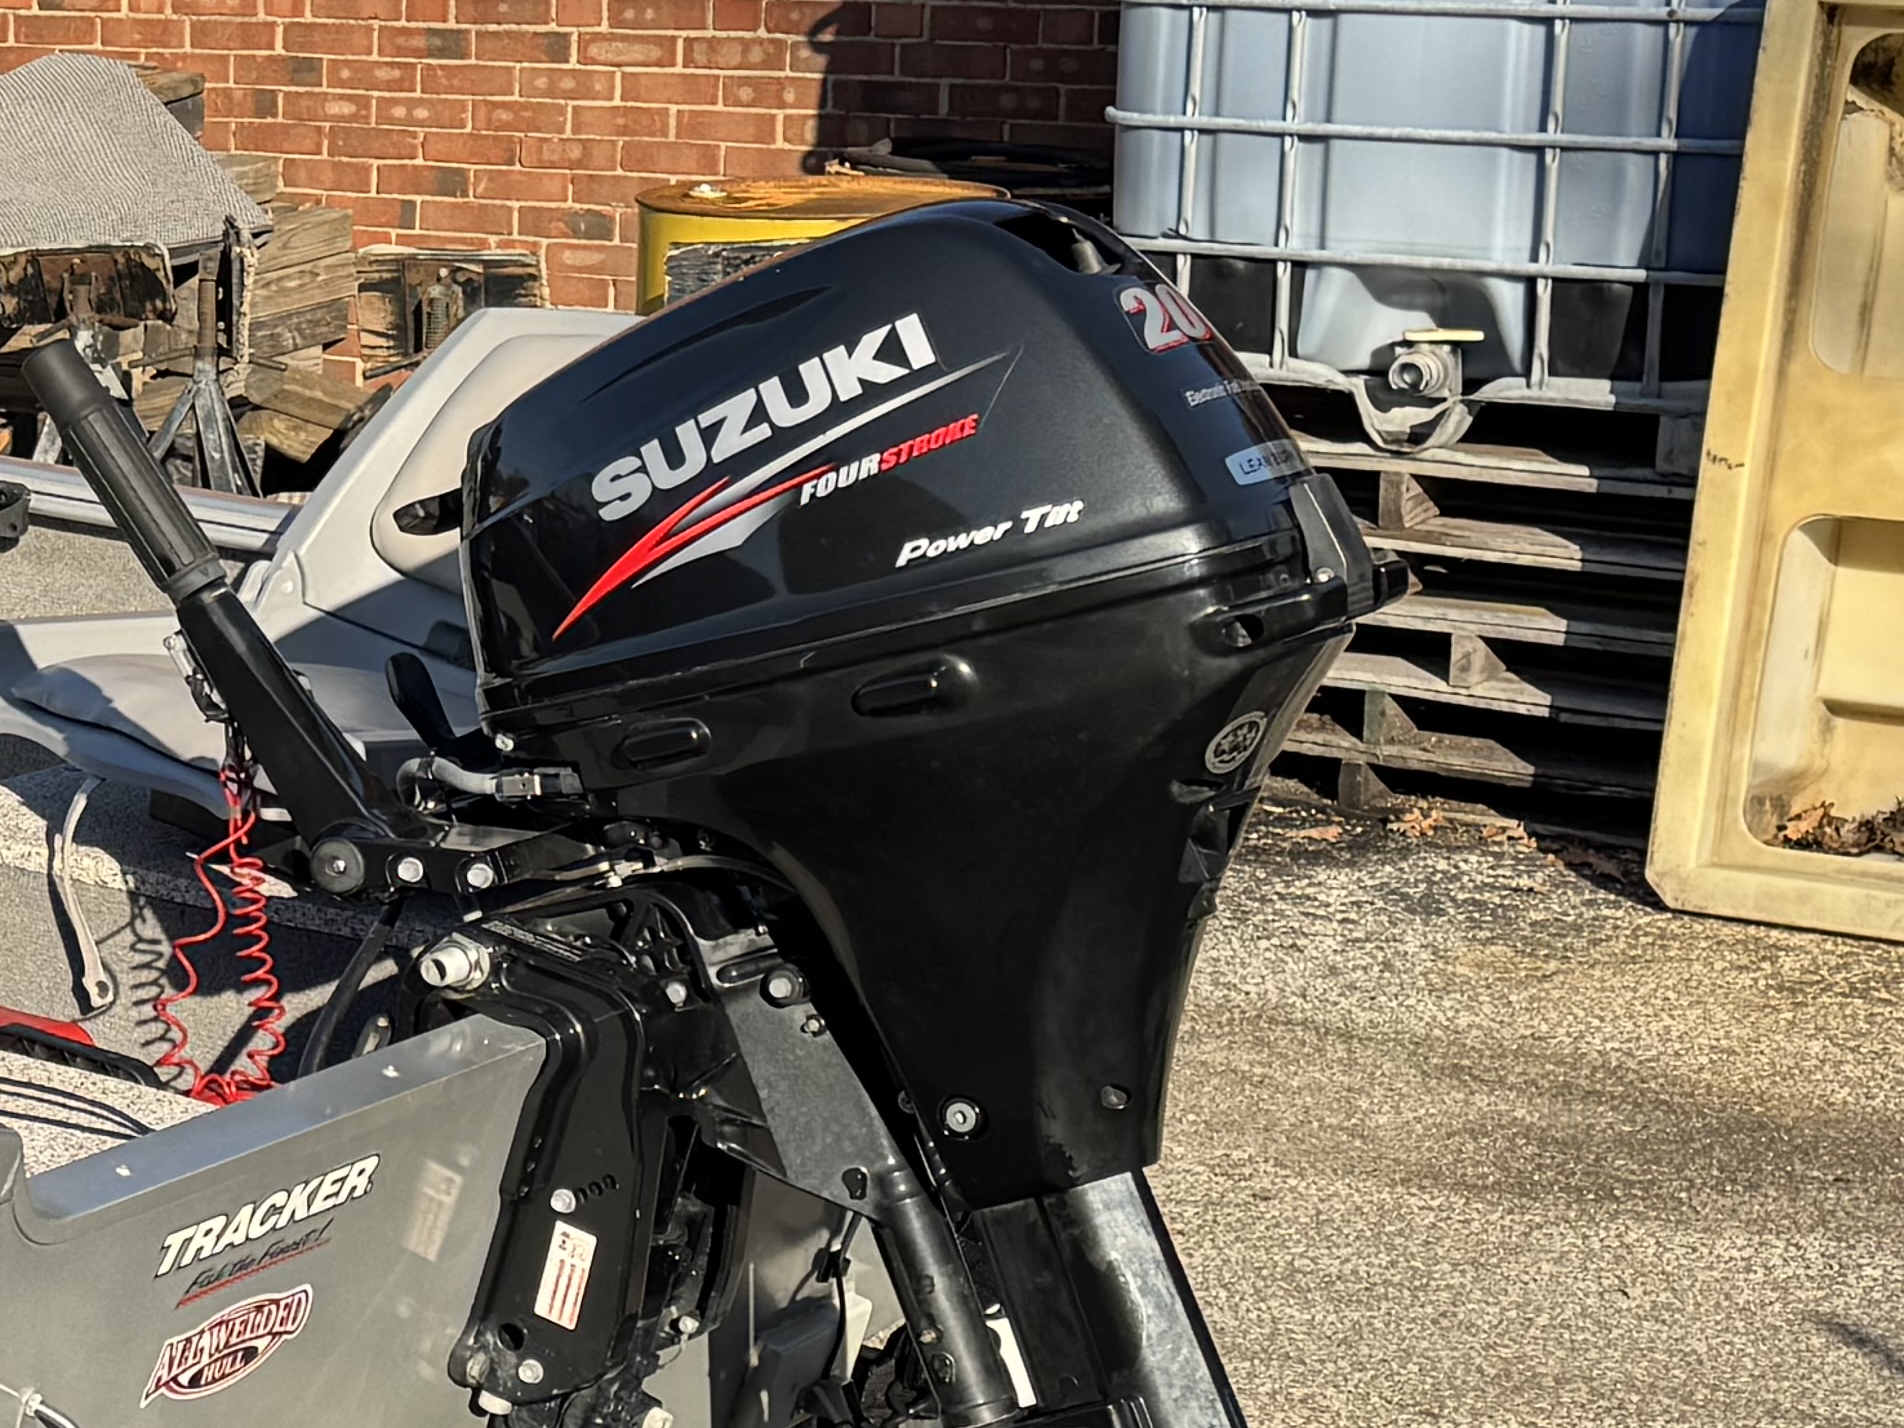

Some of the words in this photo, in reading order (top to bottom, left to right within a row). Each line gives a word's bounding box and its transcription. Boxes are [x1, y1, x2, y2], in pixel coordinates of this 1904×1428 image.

[1119, 283, 1213, 355] 20
[592, 313, 937, 522] SUZUKI
[895, 520, 1013, 568] Power
[1021, 500, 1085, 534] Tilt
[154, 1152, 381, 1278] TRACKER
[200, 1349, 246, 1385] HULL
